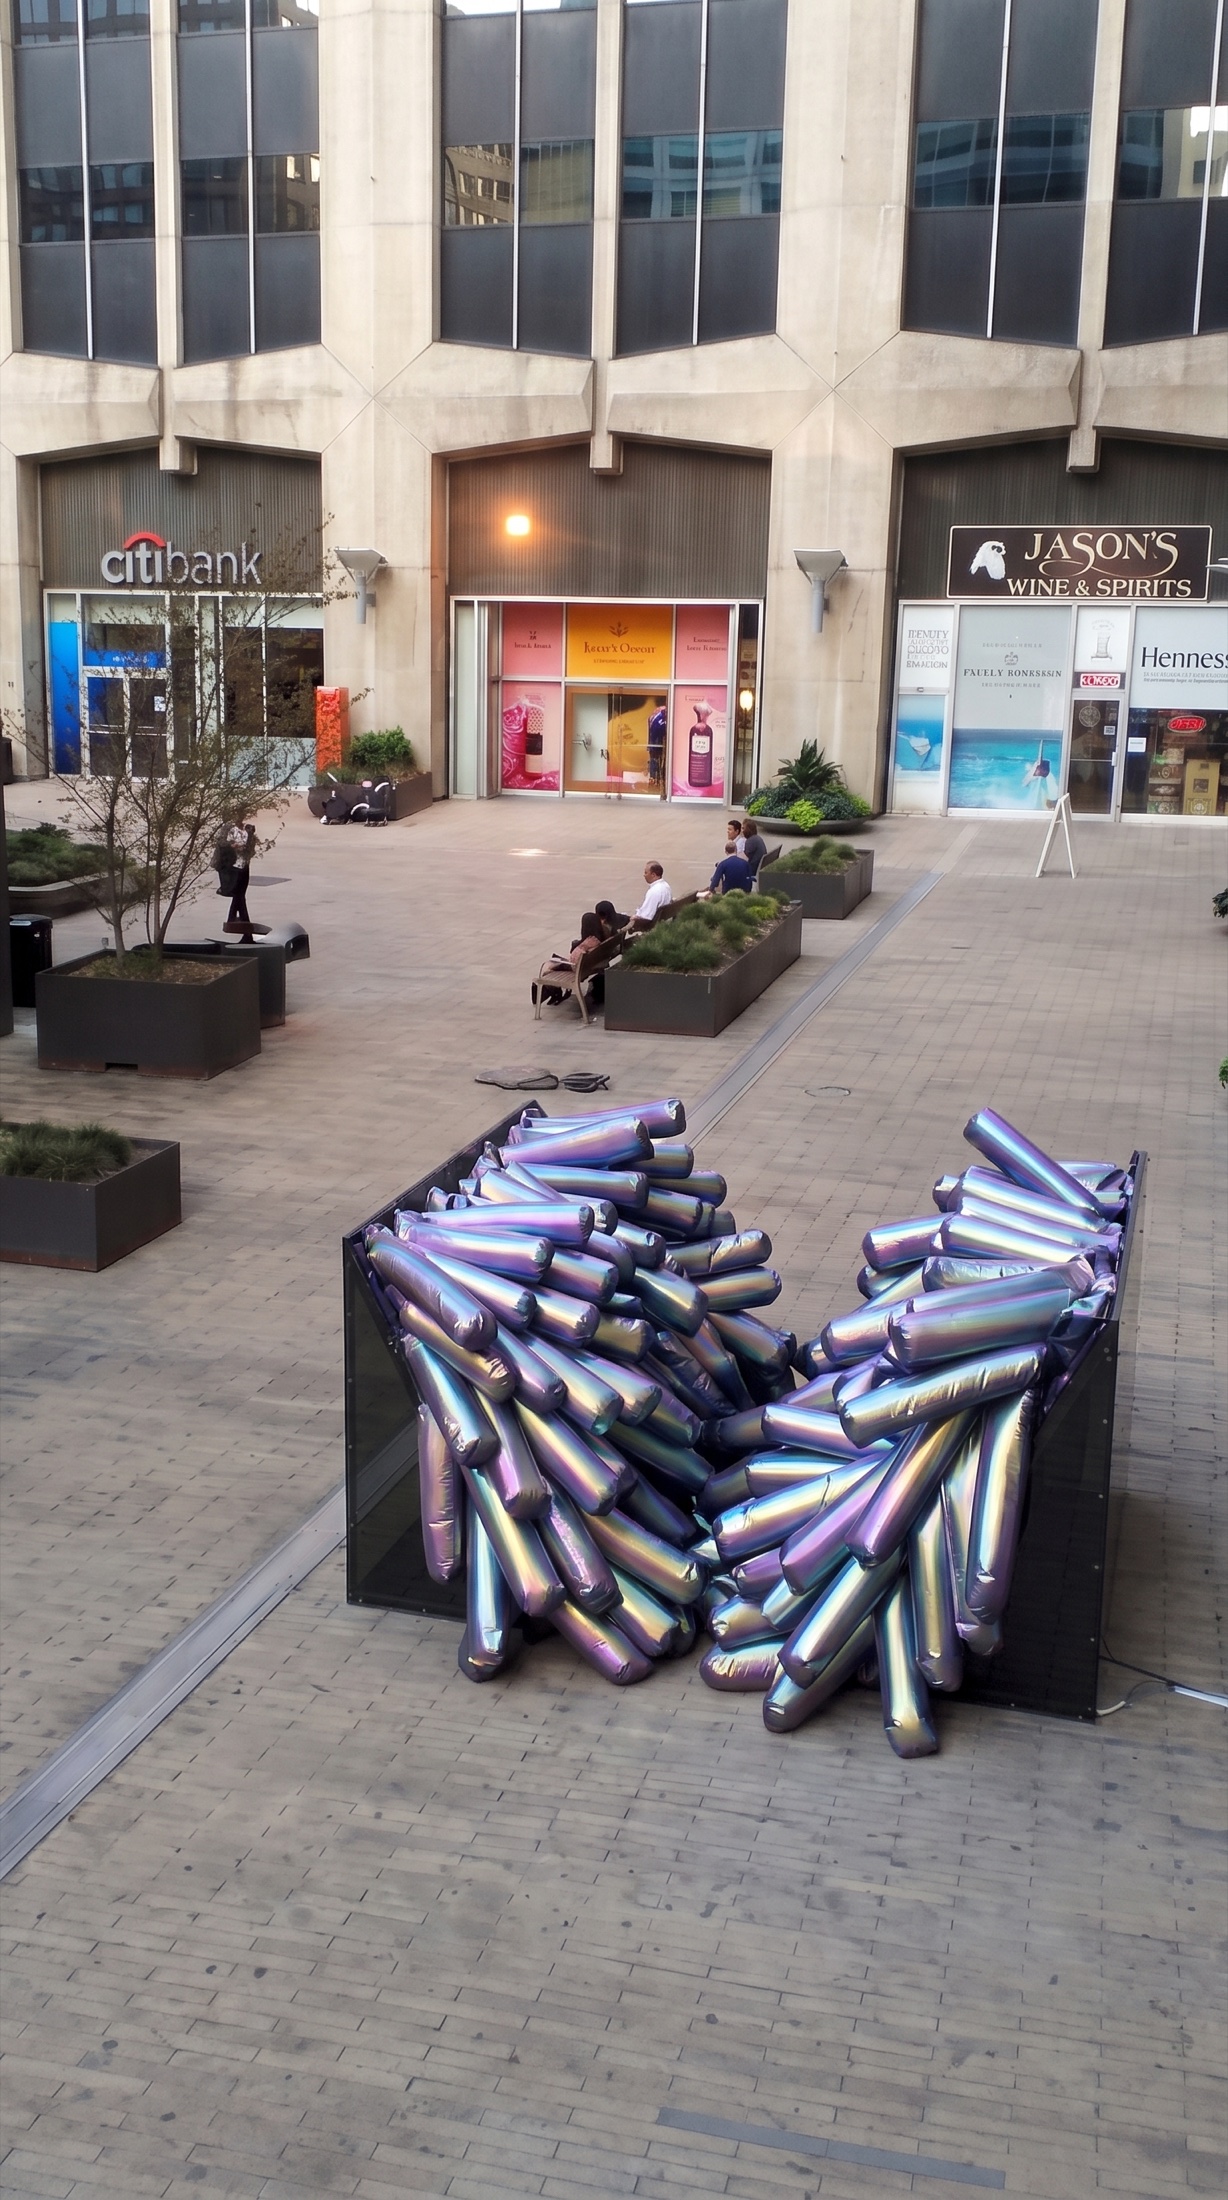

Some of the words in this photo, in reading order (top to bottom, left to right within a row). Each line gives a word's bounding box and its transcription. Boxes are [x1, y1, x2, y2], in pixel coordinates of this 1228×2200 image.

[101, 540, 262, 584] citibank
[1024, 531, 1178, 577] JASON'S
[1006, 578, 1070, 596] WINE
[1075, 579, 1091, 596] &
[1095, 579, 1191, 598] SPIRITS
